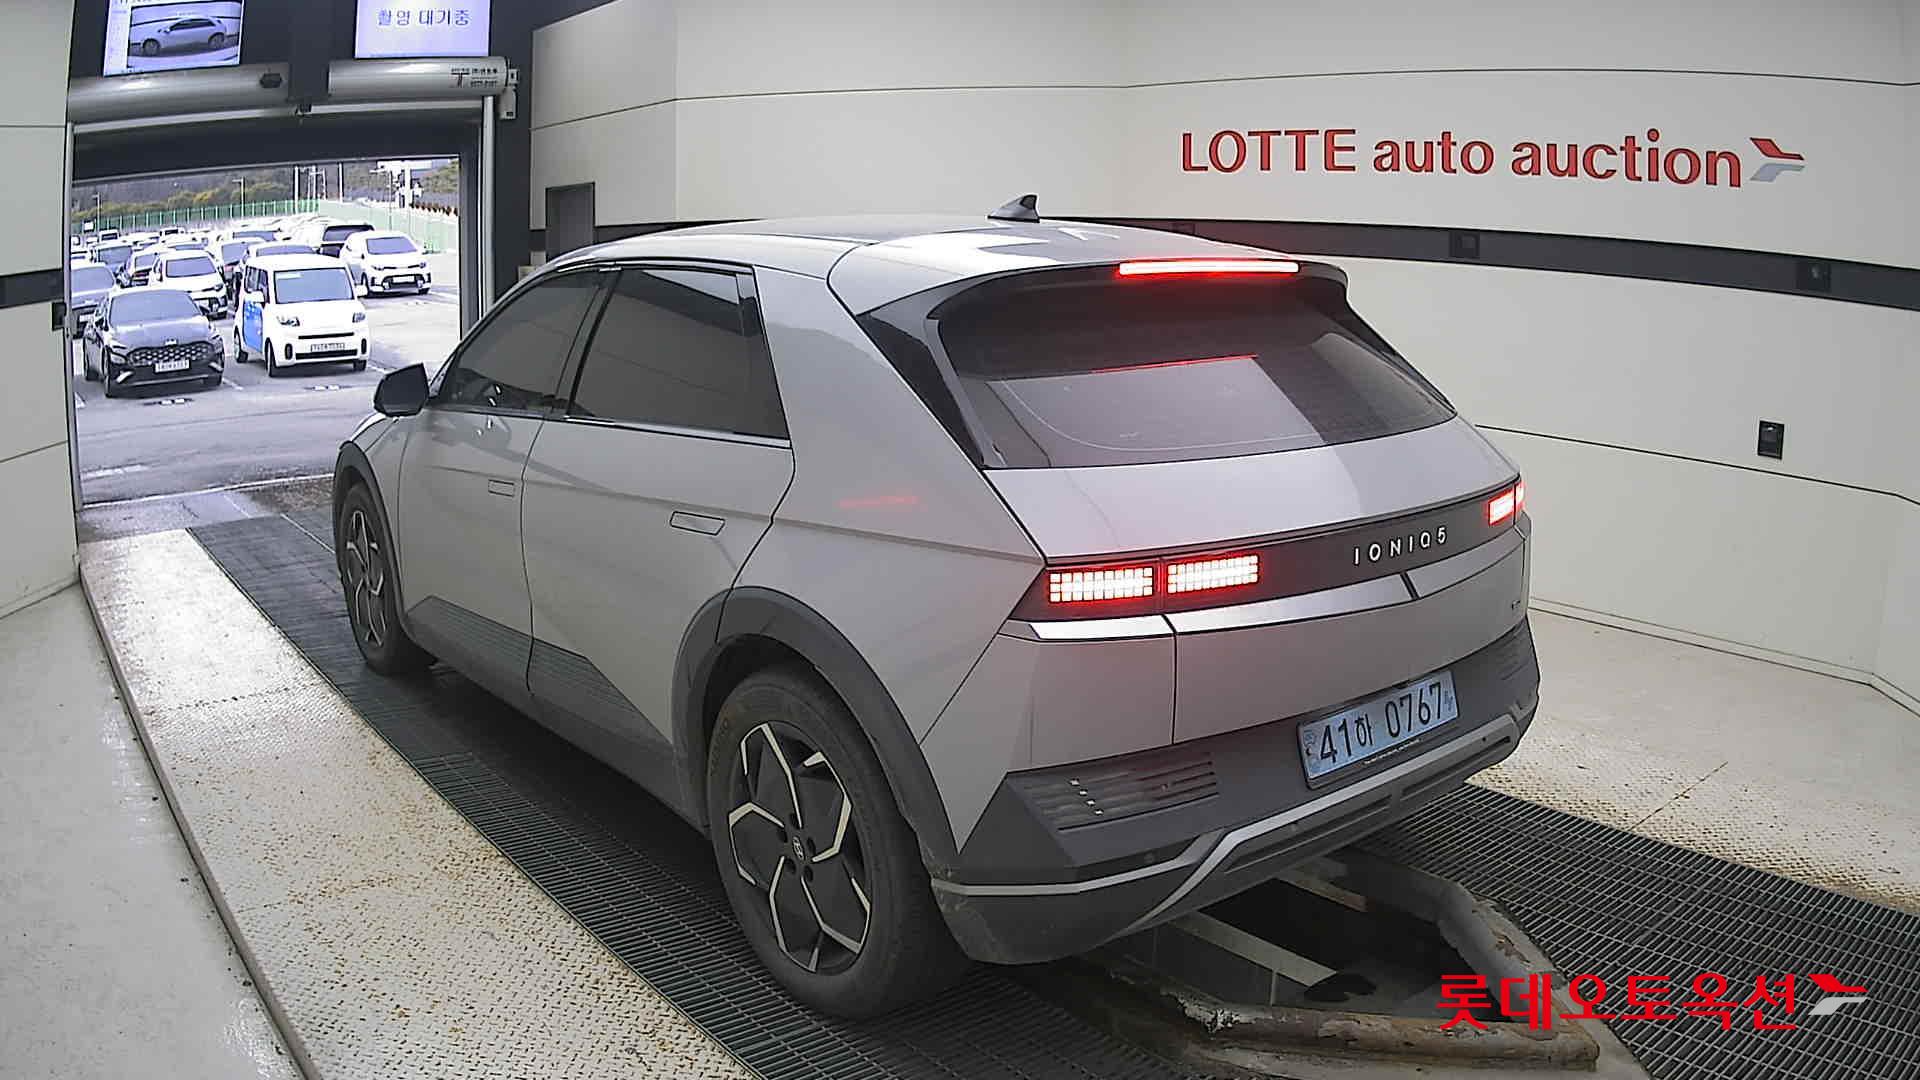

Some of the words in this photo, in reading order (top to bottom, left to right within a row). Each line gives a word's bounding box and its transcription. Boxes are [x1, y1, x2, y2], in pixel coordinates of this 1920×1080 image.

[418, 9, 470, 26] 대기중
[1181, 128, 1357, 174] LOTTE
[1372, 131, 1495, 176] auto
[1510, 128, 1743, 189] auction
[1319, 713, 1374, 764] 41하
[1384, 681, 1442, 738] 0767
